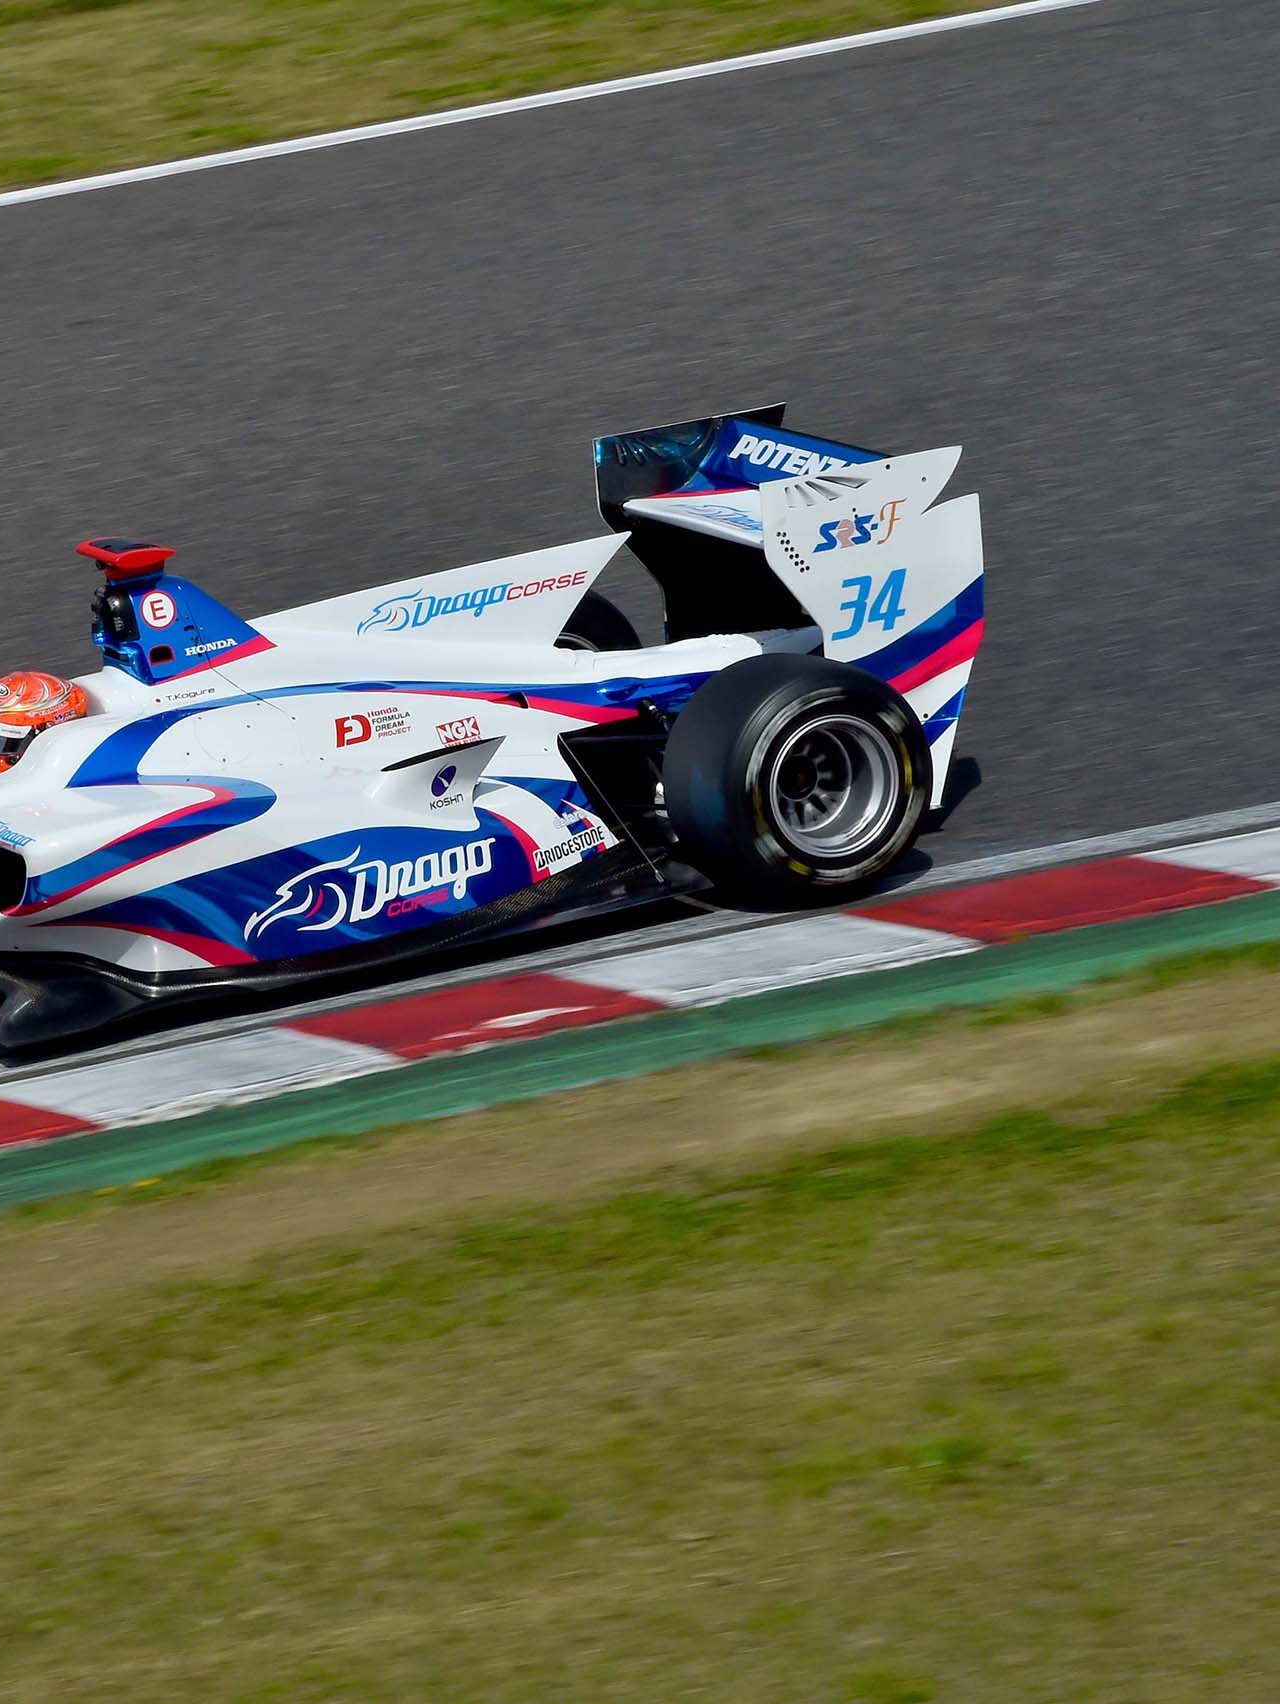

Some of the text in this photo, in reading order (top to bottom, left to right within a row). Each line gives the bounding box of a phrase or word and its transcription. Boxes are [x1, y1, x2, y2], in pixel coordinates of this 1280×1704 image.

[729, 434, 863, 476] POTENZ
[150, 599, 167, 621] E
[411, 570, 588, 628] Drago CORSE
[831, 568, 907, 641] 34
[184, 638, 238, 656] HONDA
[166, 687, 216, 704] T.Kogure
[367, 706, 399, 718] Honda
[371, 711, 411, 725] FORMULA
[375, 720, 405, 733] DREAM
[378, 726, 412, 739] PROJECT
[436, 716, 481, 744] NGK
[534, 826, 605, 869] BRIDGESTONE
[348, 837, 496, 923] Drago
